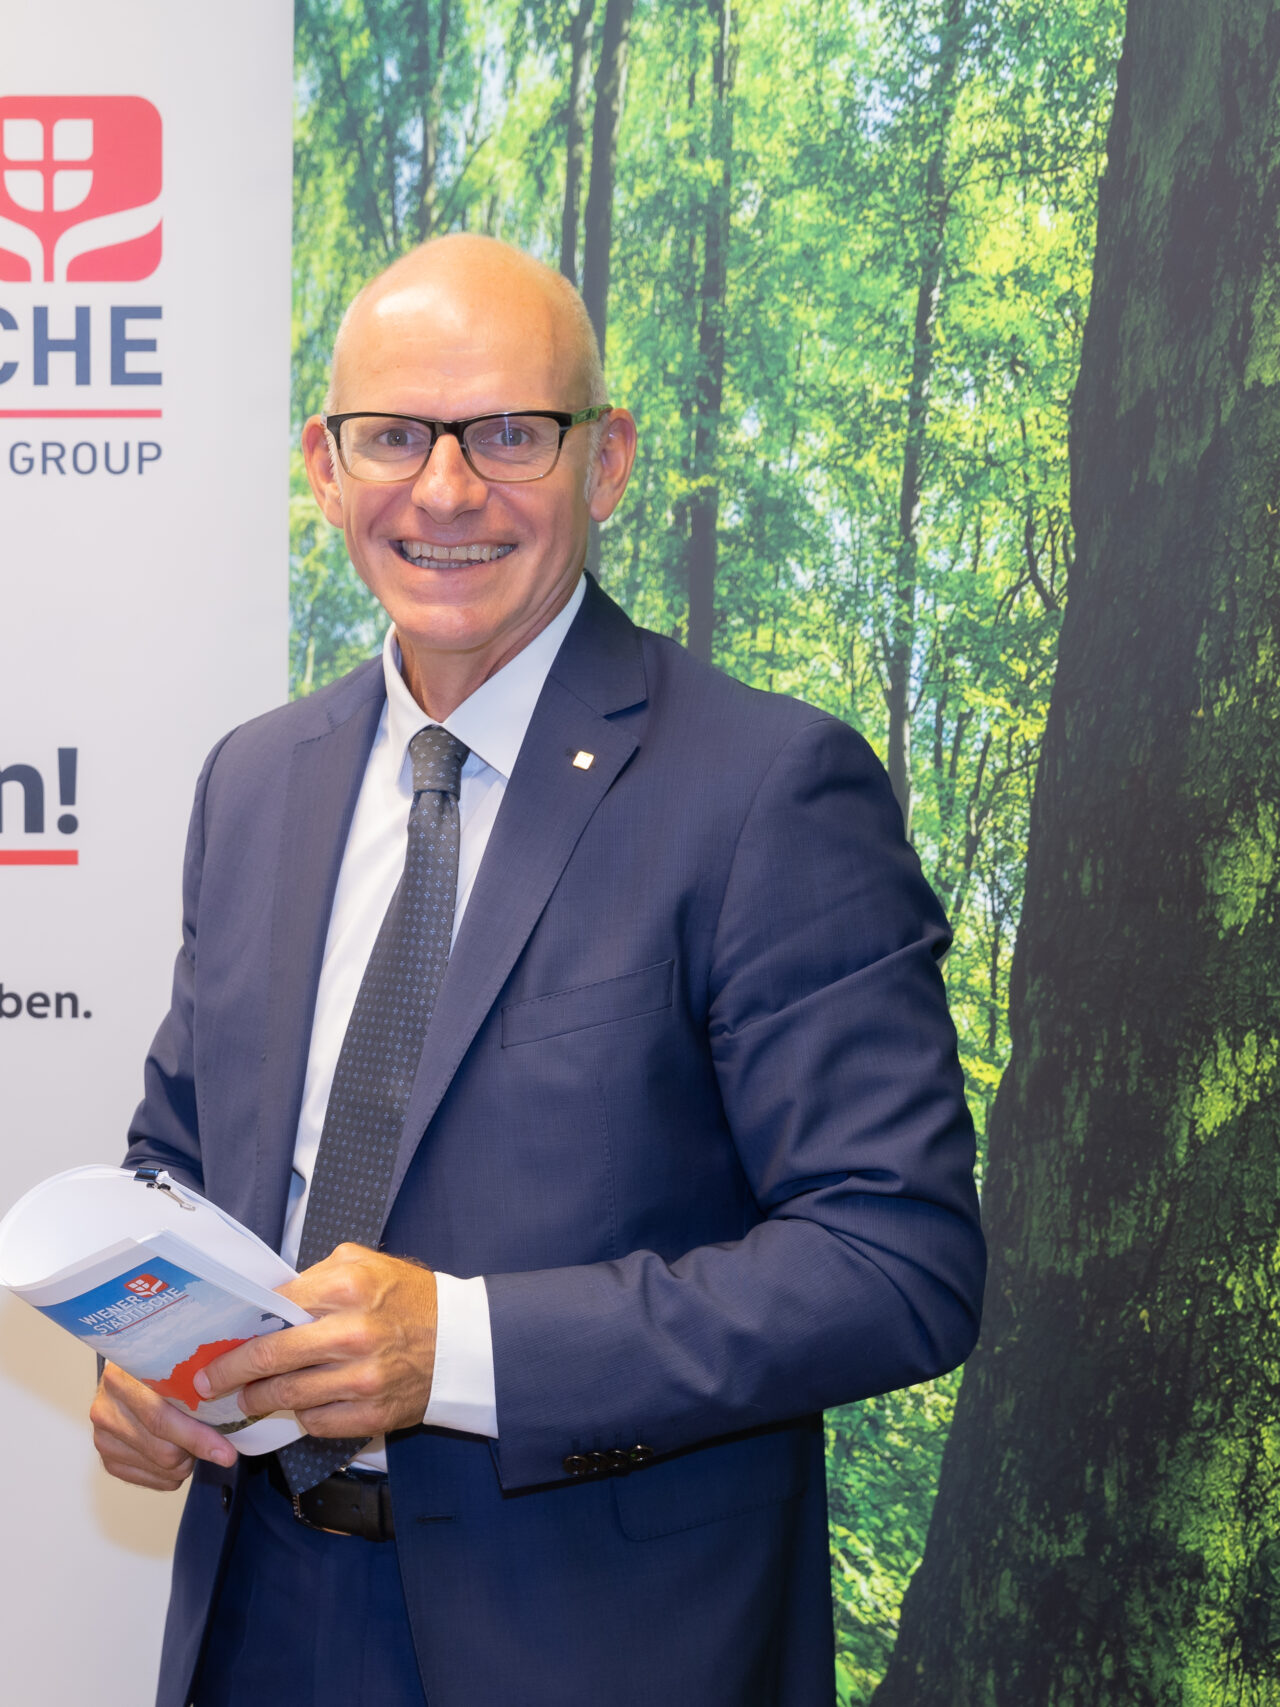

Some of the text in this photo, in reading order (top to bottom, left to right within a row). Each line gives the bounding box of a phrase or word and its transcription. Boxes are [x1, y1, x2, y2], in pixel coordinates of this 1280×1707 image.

[9, 441, 163, 476] GROUP
[78, 1295, 144, 1326] WIENER
[93, 1287, 184, 1335] STÄDTISCHE
